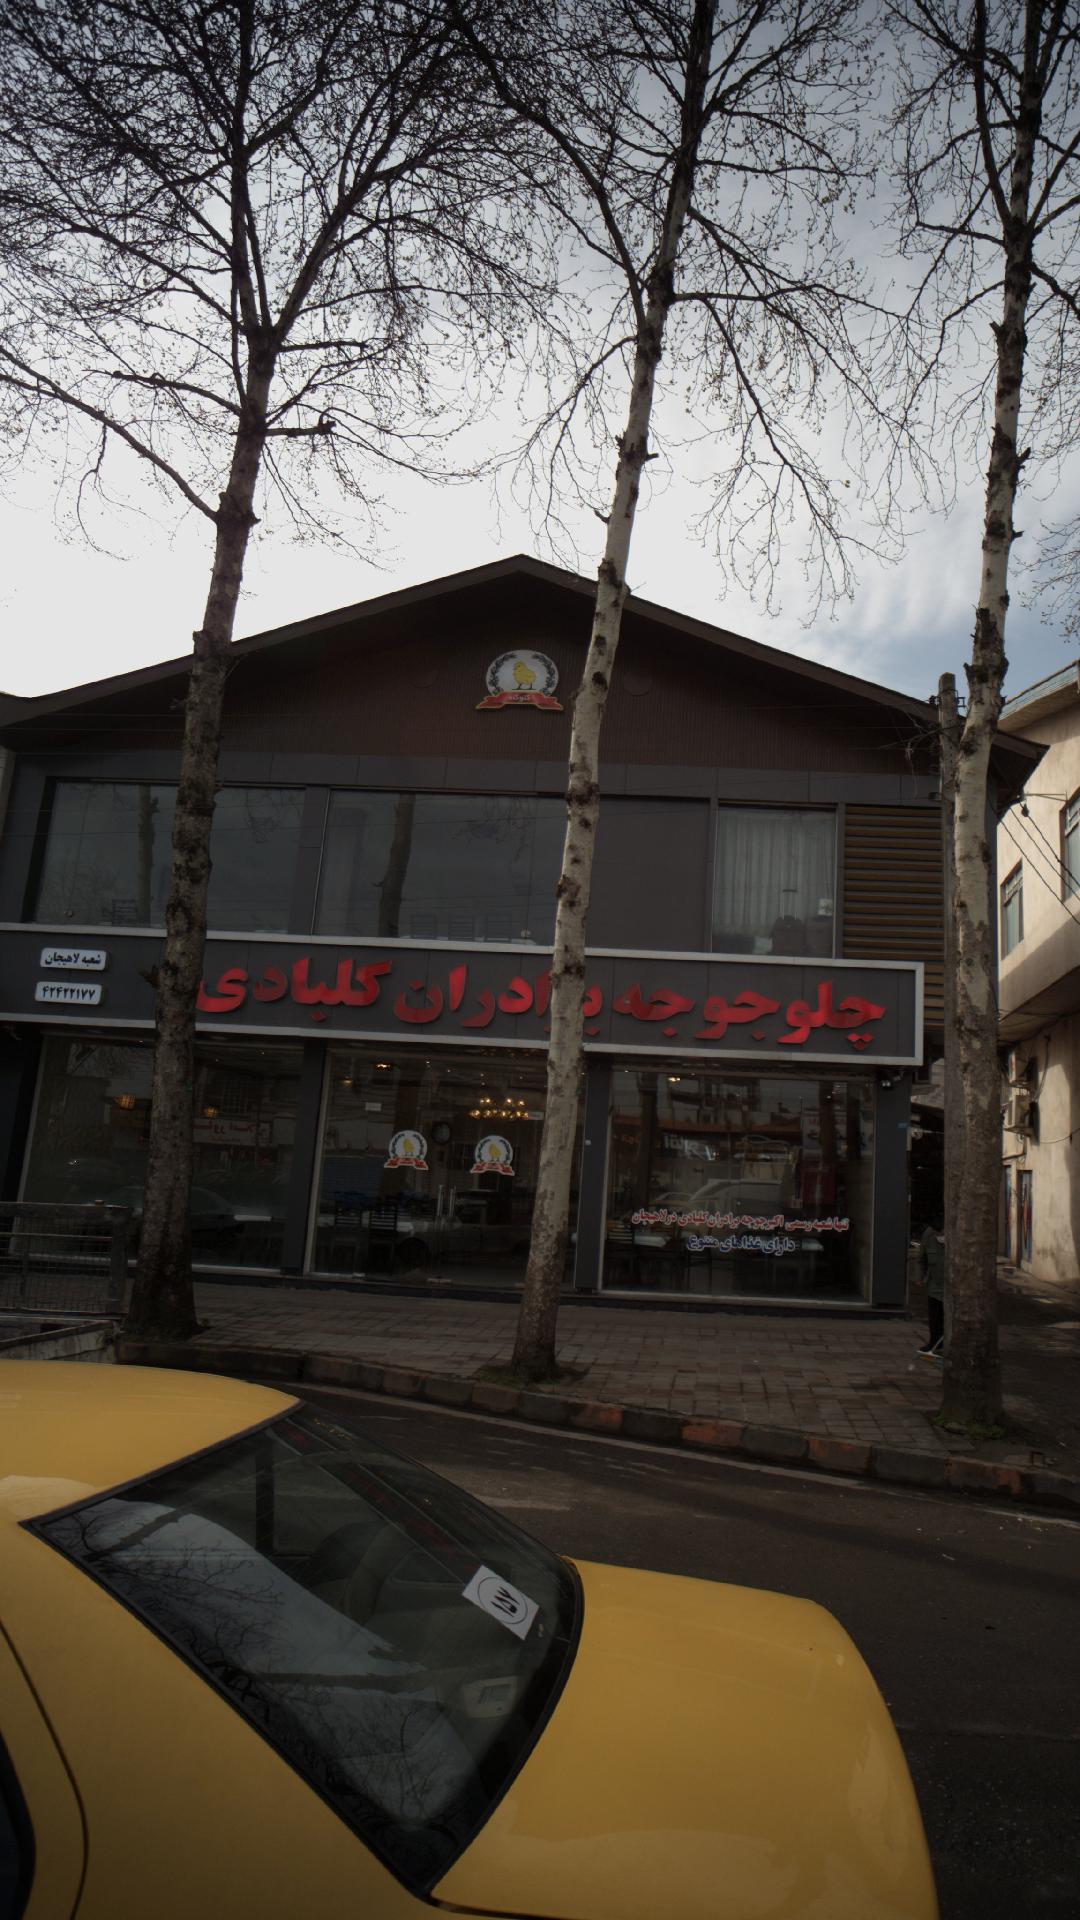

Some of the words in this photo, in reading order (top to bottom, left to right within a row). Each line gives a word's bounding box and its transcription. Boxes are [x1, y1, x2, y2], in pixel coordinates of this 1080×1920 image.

[44, 951, 80, 966] لاهیجان
[81, 953, 102, 967] شعبه
[392, 962, 603, 1038] بادران
[686, 1235, 719, 1251] متنوع
[762, 1236, 796, 1256] دارای
